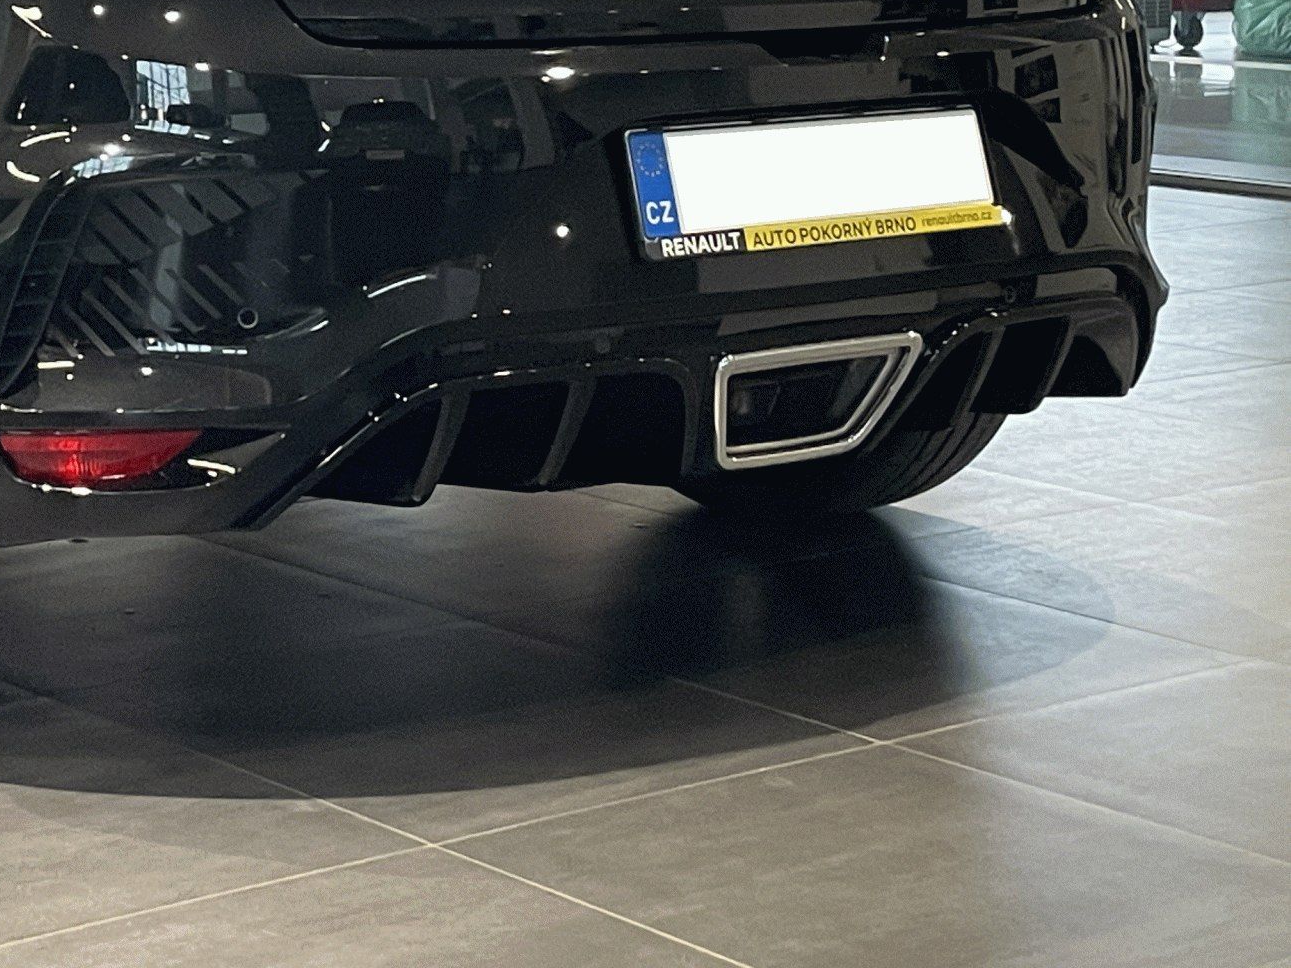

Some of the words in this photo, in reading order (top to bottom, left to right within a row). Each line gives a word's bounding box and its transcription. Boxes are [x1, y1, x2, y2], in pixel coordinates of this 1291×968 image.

[645, 200, 674, 225] CZ
[661, 232, 741, 258] RENAULT
[753, 229, 797, 248] AUTO
[800, 217, 873, 243] POKORNÝ
[876, 216, 917, 235] BRNO
[921, 209, 993, 228] renaultbrno.cz
